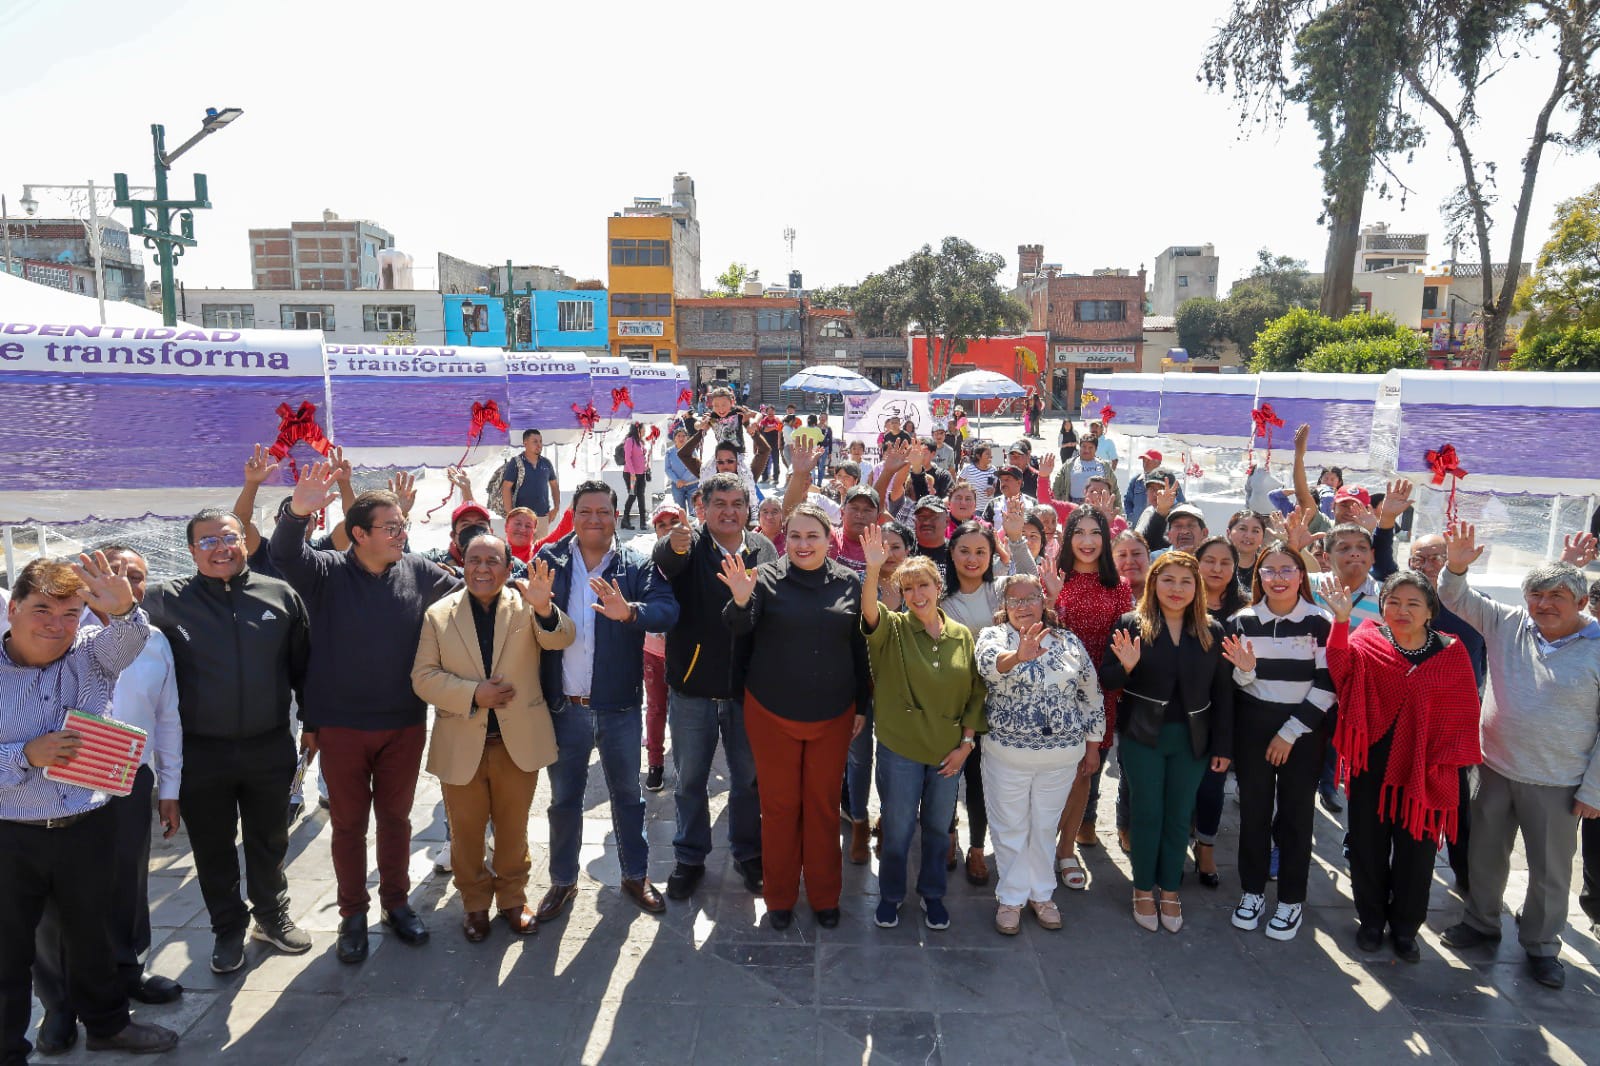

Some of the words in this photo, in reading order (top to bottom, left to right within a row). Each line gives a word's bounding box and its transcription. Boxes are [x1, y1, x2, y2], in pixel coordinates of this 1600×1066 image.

[44, 341, 289, 370] transforma
[1057, 345, 1133, 353] FOTOVISION
[347, 357, 487, 373] transforma
